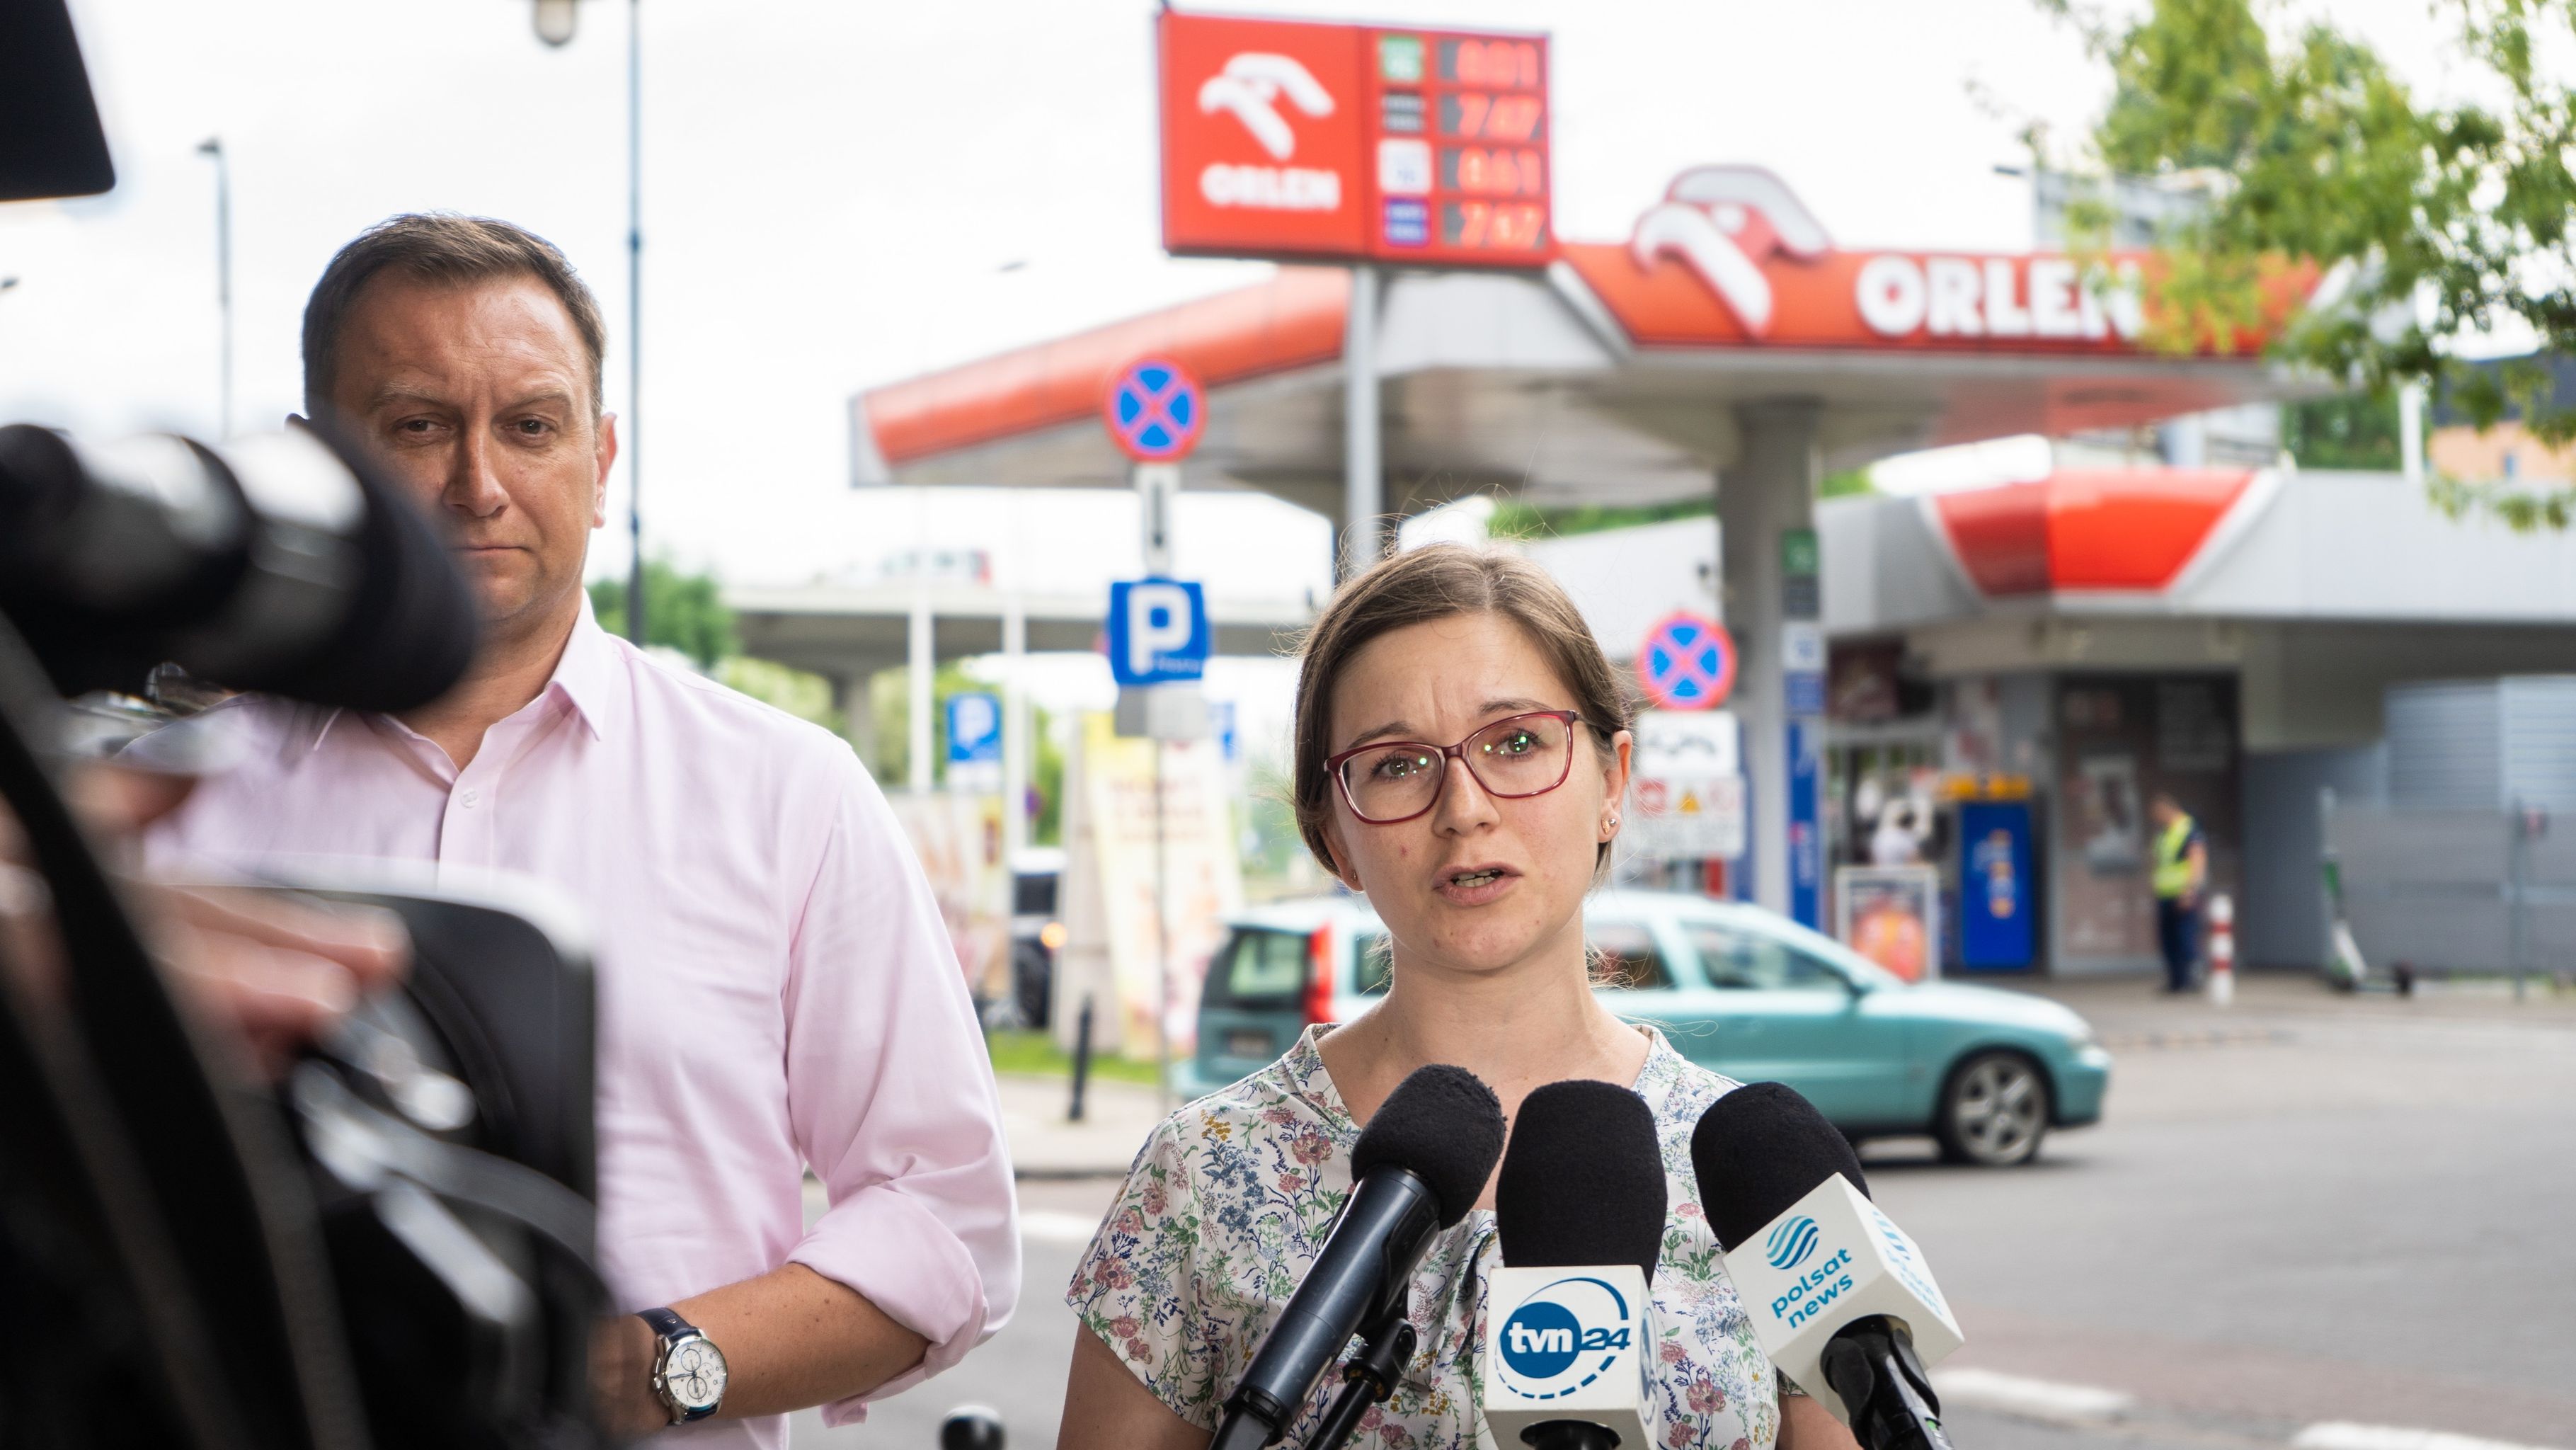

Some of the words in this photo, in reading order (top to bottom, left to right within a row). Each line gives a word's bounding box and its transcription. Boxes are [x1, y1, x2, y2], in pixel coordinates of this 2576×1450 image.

[1200, 164, 1341, 210] ORLEN
[1855, 254, 2143, 338] ORLEN
[1128, 584, 1192, 675] P
[1771, 1248, 1852, 1318] polsat
[1788, 1274, 1853, 1328] news
